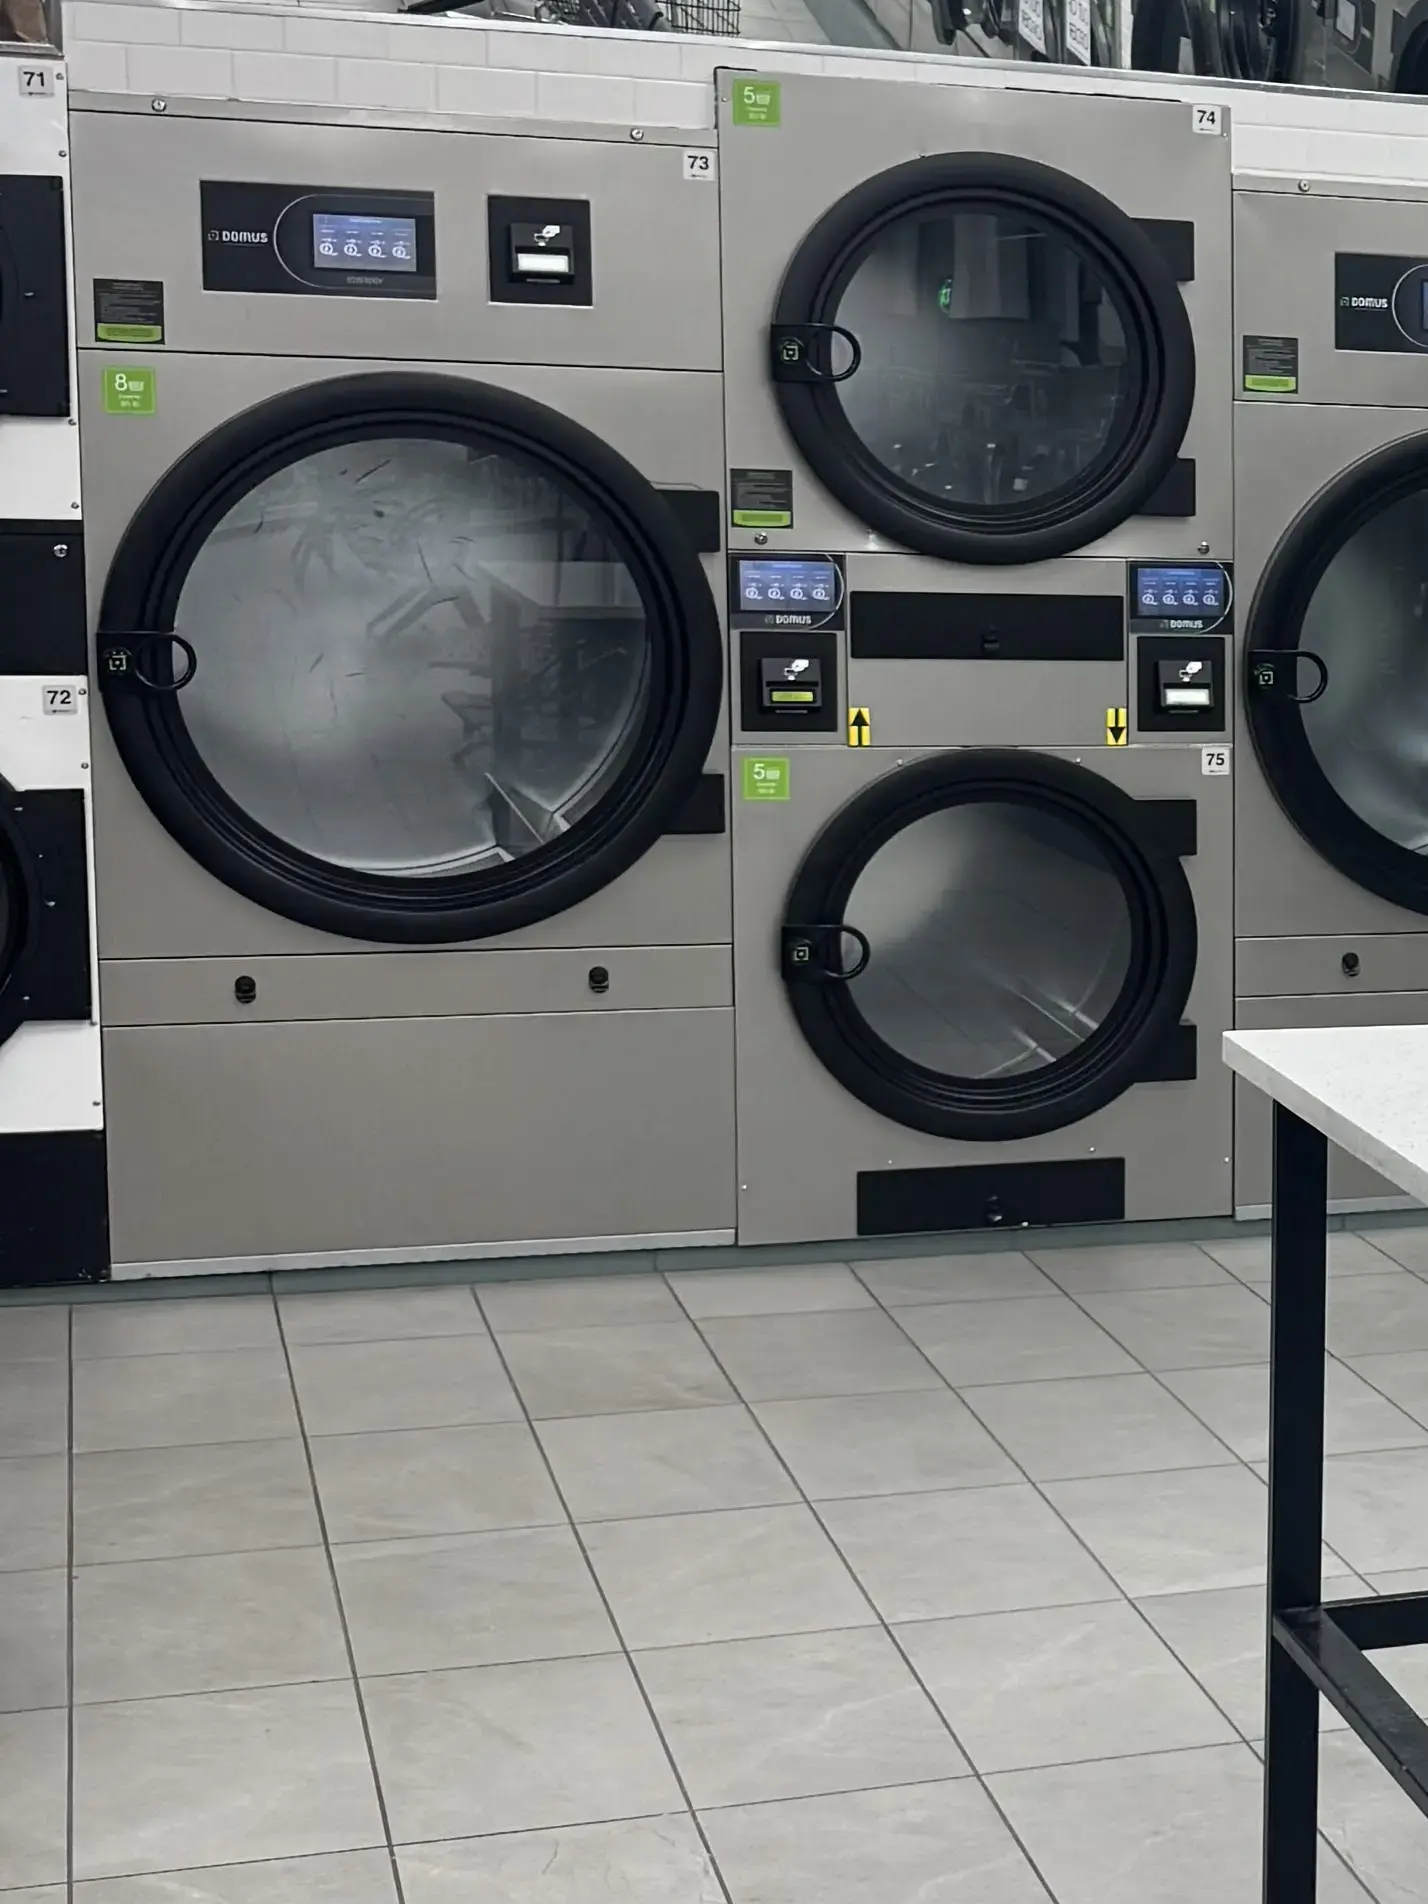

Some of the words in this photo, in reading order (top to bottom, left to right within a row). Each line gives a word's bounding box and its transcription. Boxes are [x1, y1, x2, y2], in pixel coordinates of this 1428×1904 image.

[23, 71, 45, 87] 71
[743, 86, 755, 103] 5
[1197, 109, 1216, 125] 74
[687, 155, 709, 170] 73
[222, 230, 268, 243] DOMUS
[1351, 297, 1388, 308] DOMUS
[115, 373, 127, 392] 8
[776, 614, 812, 625] DOMUS
[1170, 619, 1204, 629] DOMUS
[46, 690, 72, 705] 72
[1206, 753, 1225, 766] 75
[753, 763, 765, 780] 5
